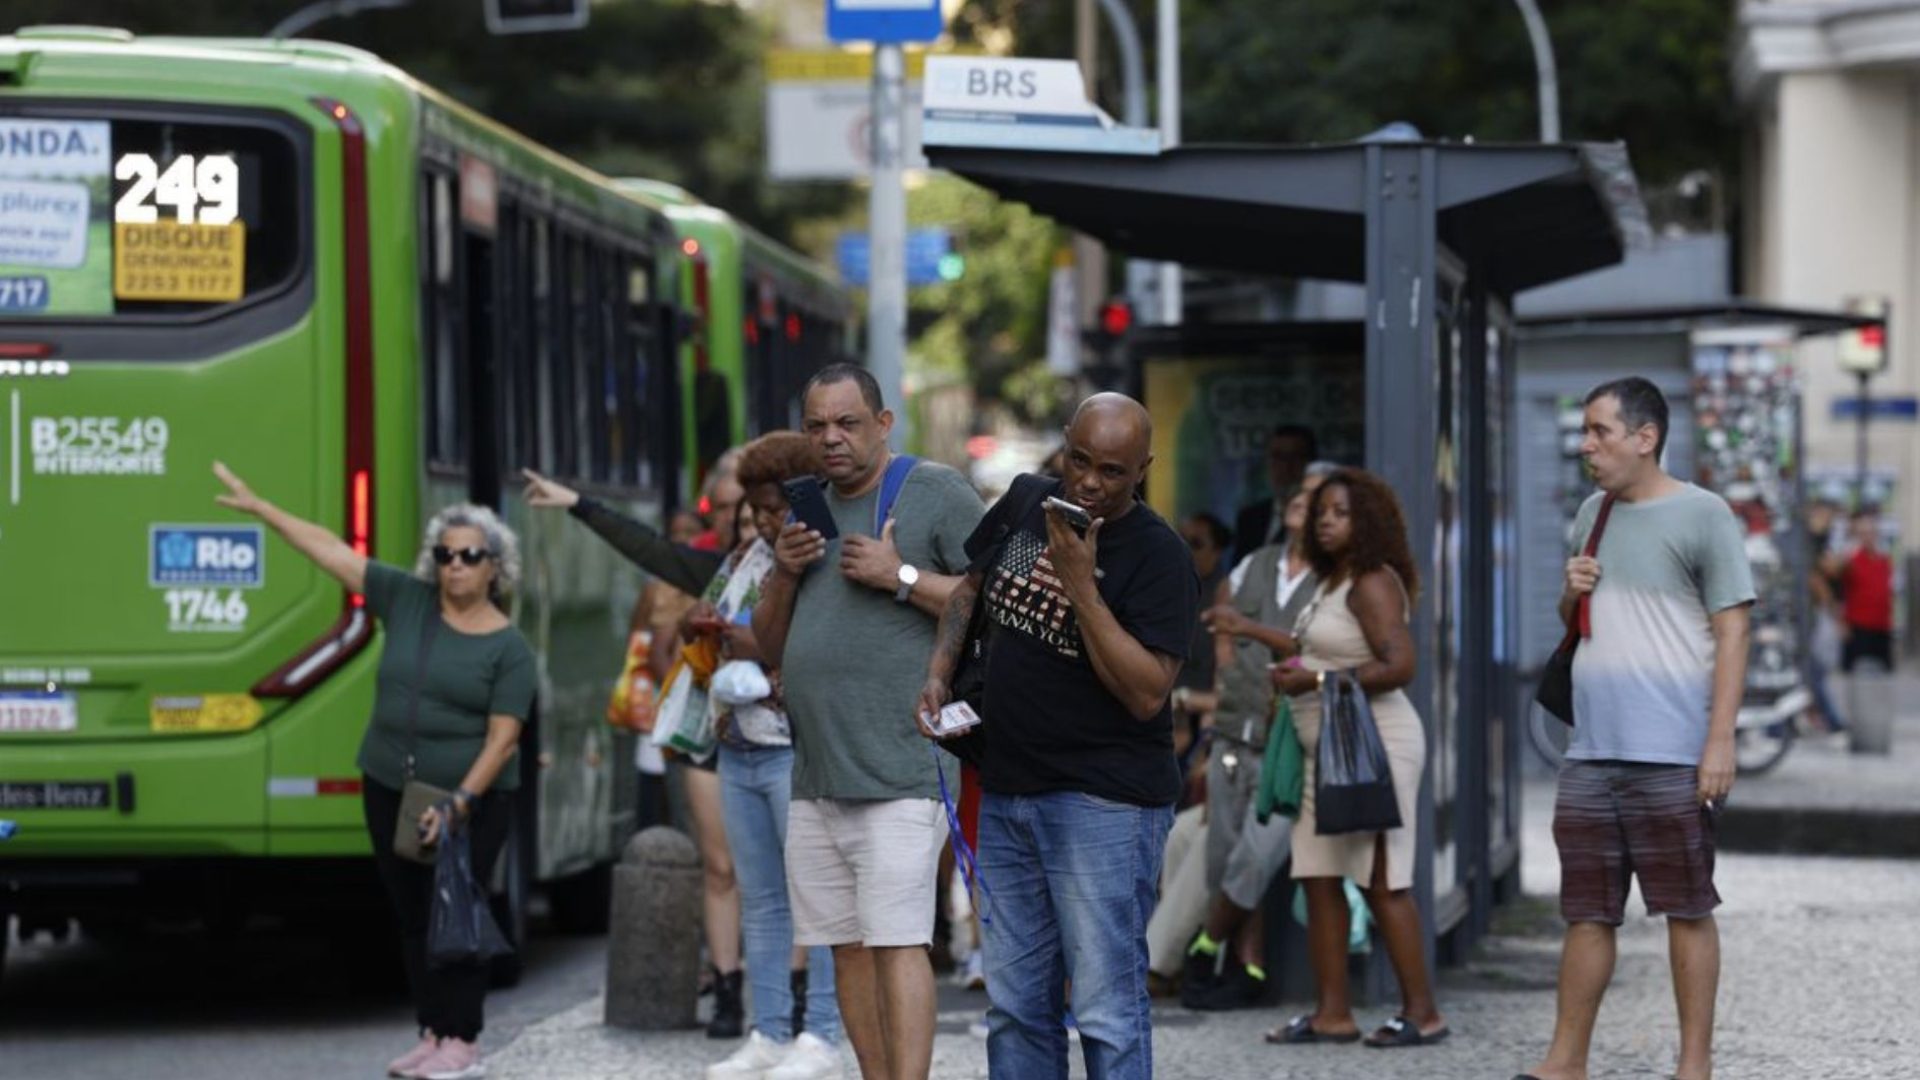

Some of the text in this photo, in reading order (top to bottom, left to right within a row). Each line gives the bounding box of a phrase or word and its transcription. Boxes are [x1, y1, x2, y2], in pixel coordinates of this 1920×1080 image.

[967, 68, 1037, 98] BRS
[0, 129, 99, 156] NDA.
[115, 154, 238, 224] 249
[124, 225, 232, 249] DISQUE
[31, 416, 168, 453] B25549
[33, 453, 166, 475] INTERNORTE
[196, 536, 256, 570] Rio
[164, 589, 248, 624] 1746
